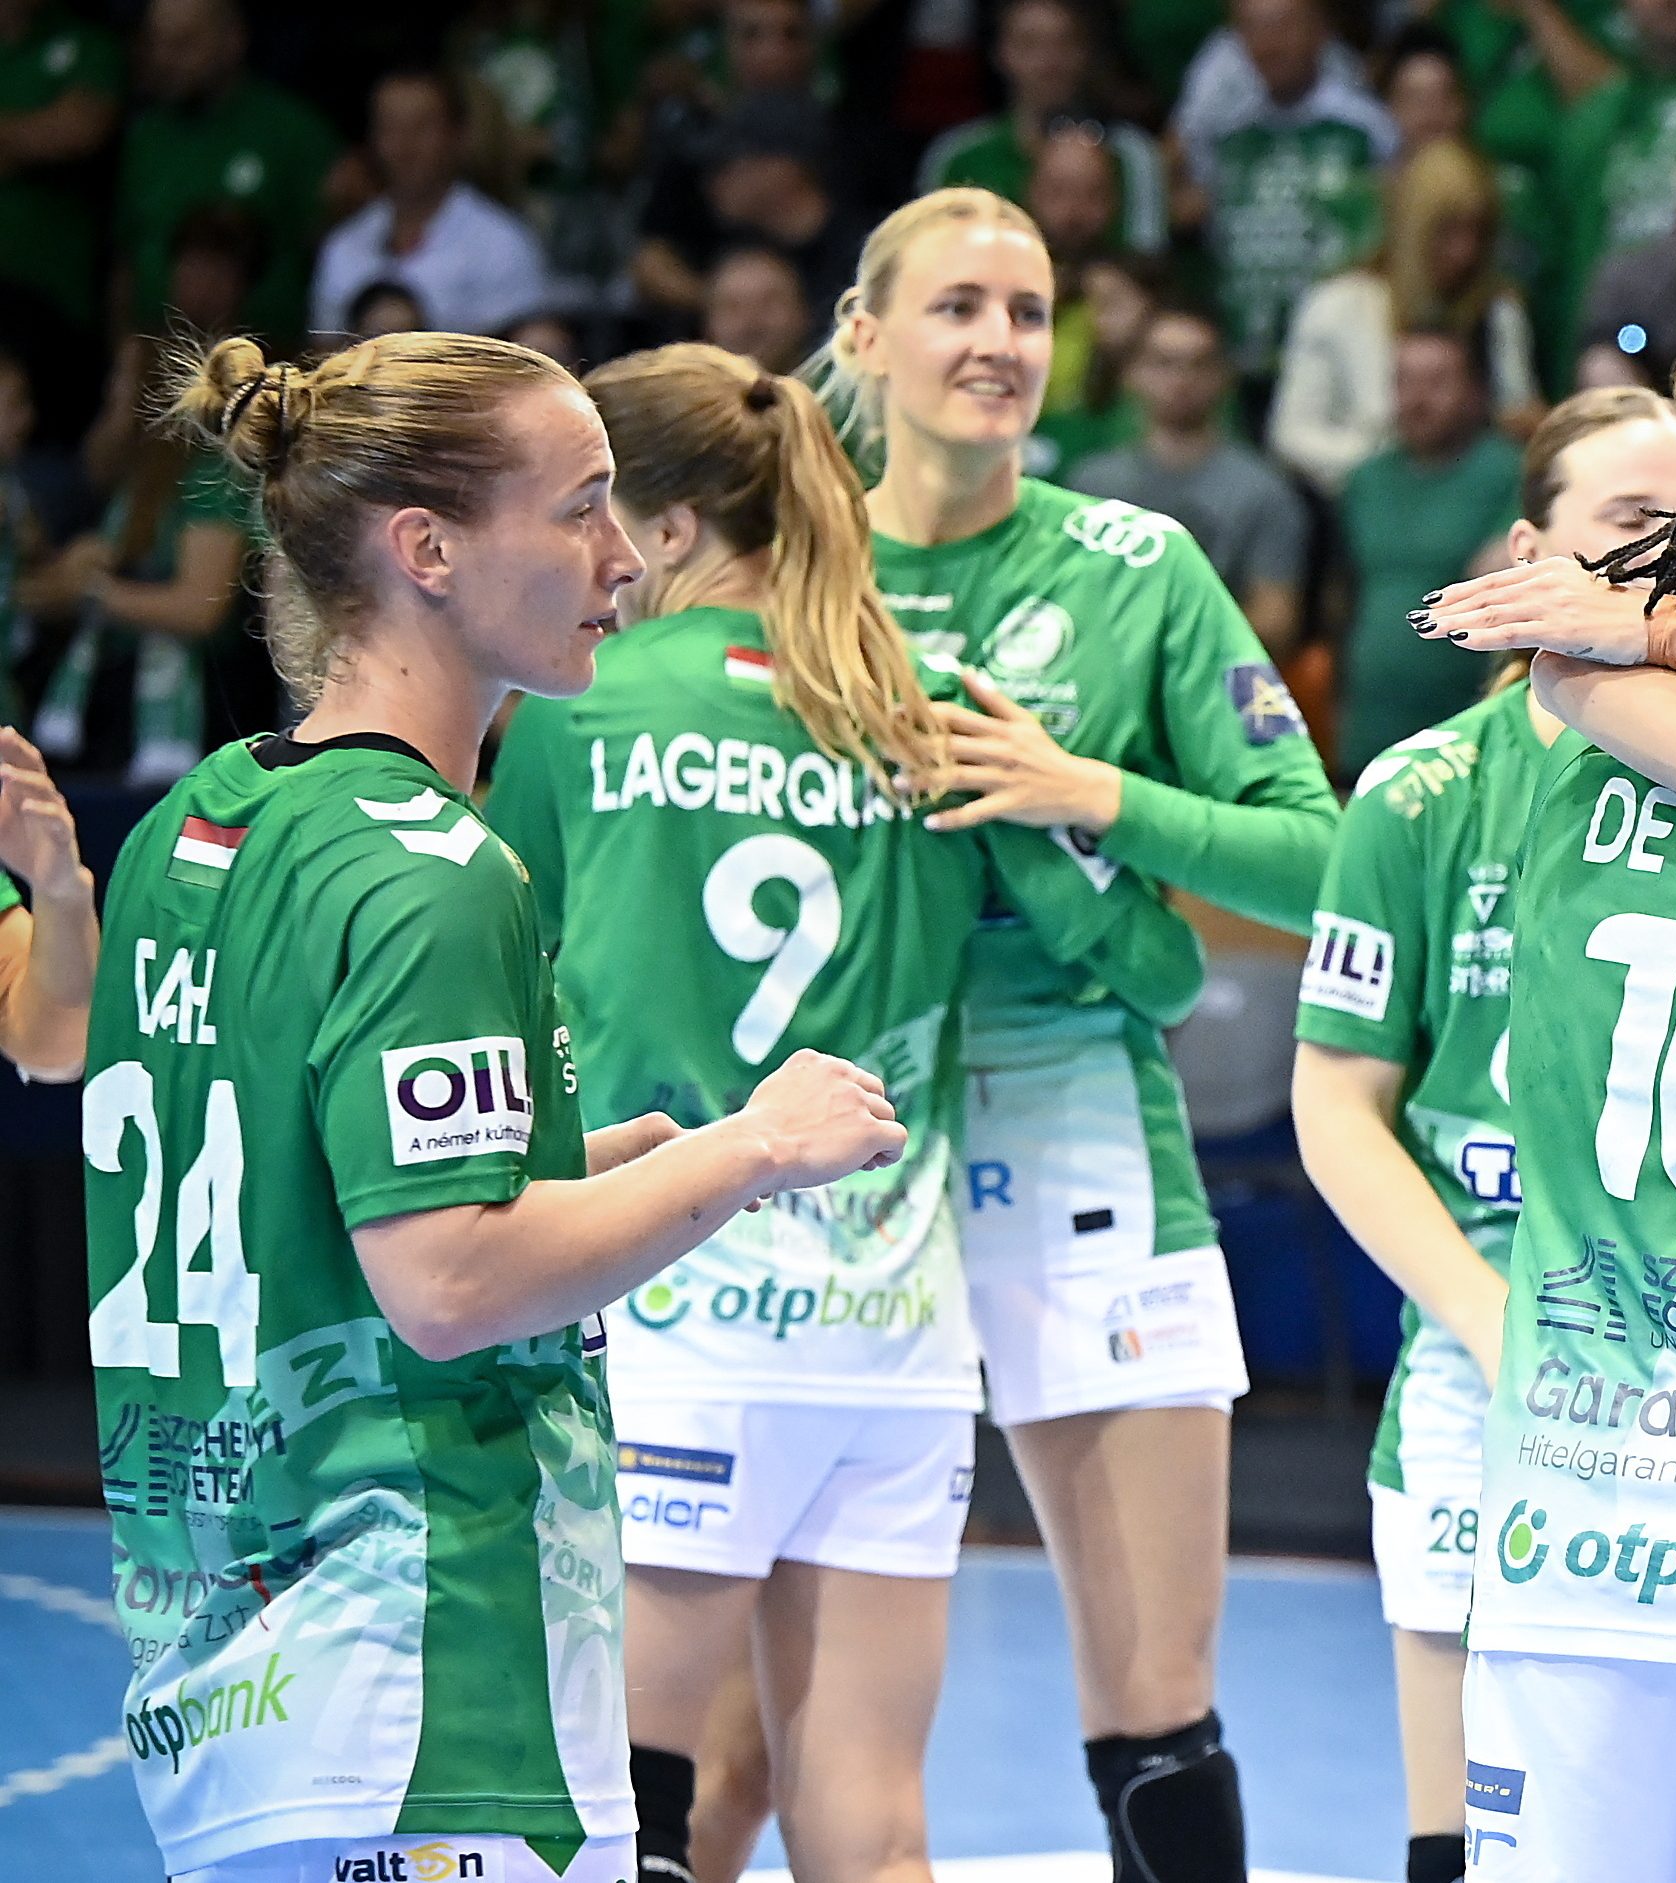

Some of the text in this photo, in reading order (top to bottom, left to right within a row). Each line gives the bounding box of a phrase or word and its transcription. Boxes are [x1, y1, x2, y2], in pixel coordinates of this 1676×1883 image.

[702, 833, 842, 1065] 9
[409, 1137, 422, 1152] A
[427, 1129, 480, 1150] német
[82, 1060, 260, 1388] 24
[1428, 1507, 1479, 1554] 28
